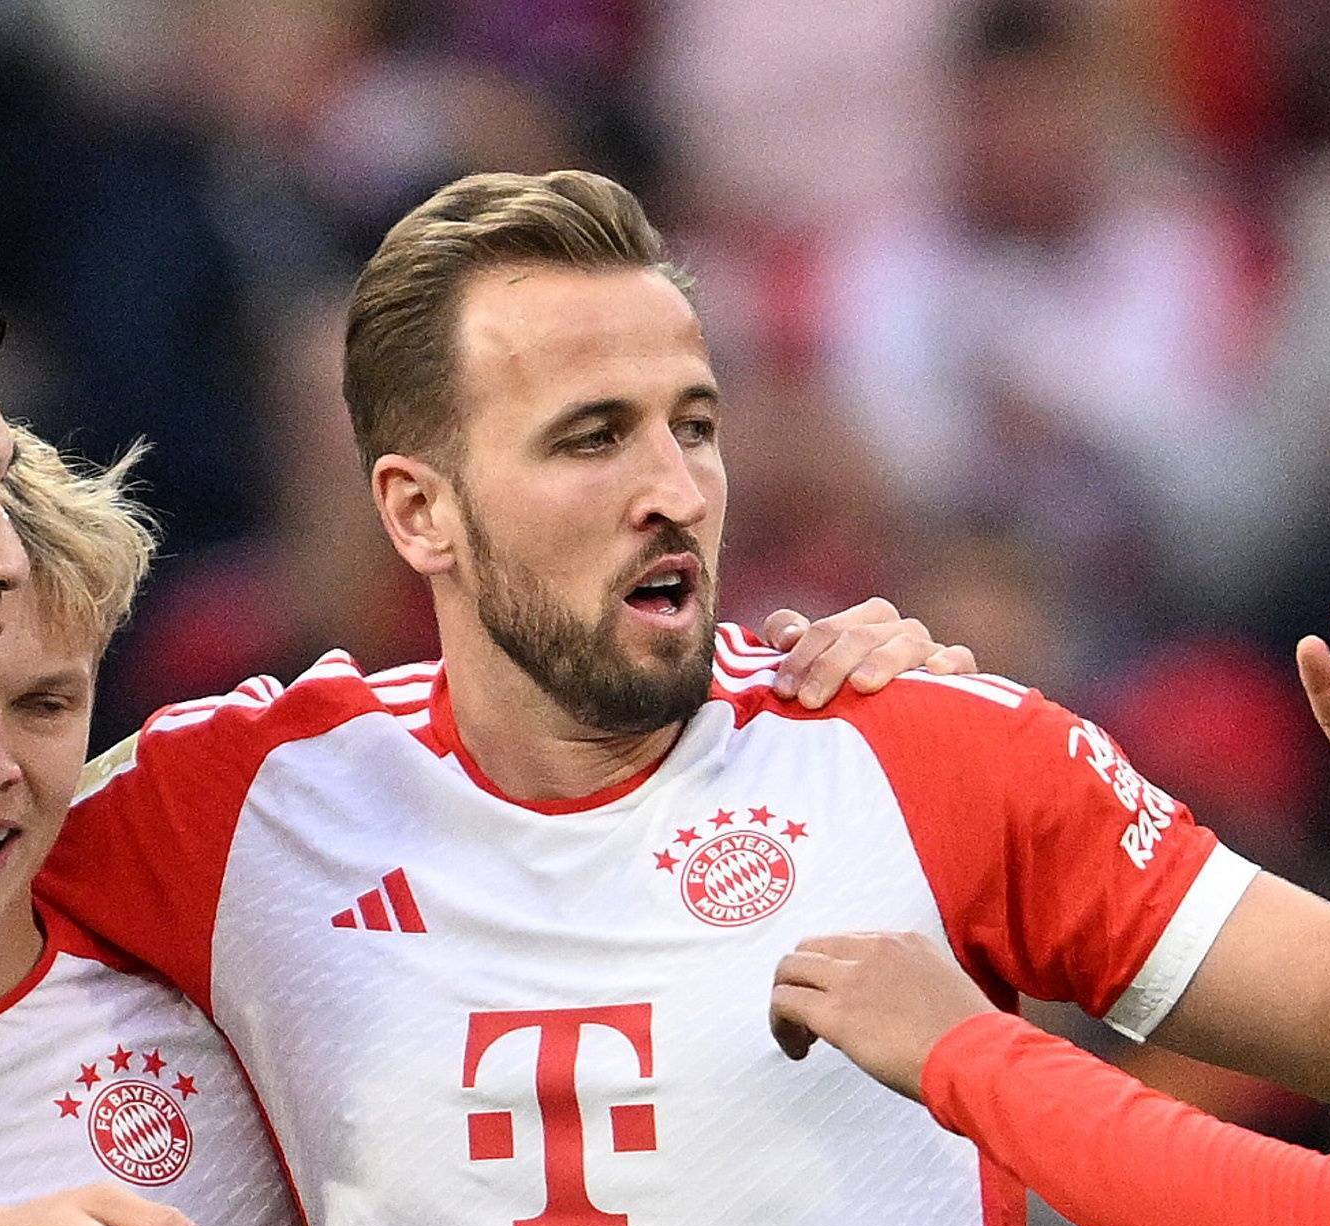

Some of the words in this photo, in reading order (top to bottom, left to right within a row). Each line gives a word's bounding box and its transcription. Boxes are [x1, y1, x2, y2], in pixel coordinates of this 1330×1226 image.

[689, 859, 709, 884] FC
[704, 836, 781, 864] BAYERN
[96, 1106, 113, 1131] FC
[109, 1087, 177, 1120] BAYERN
